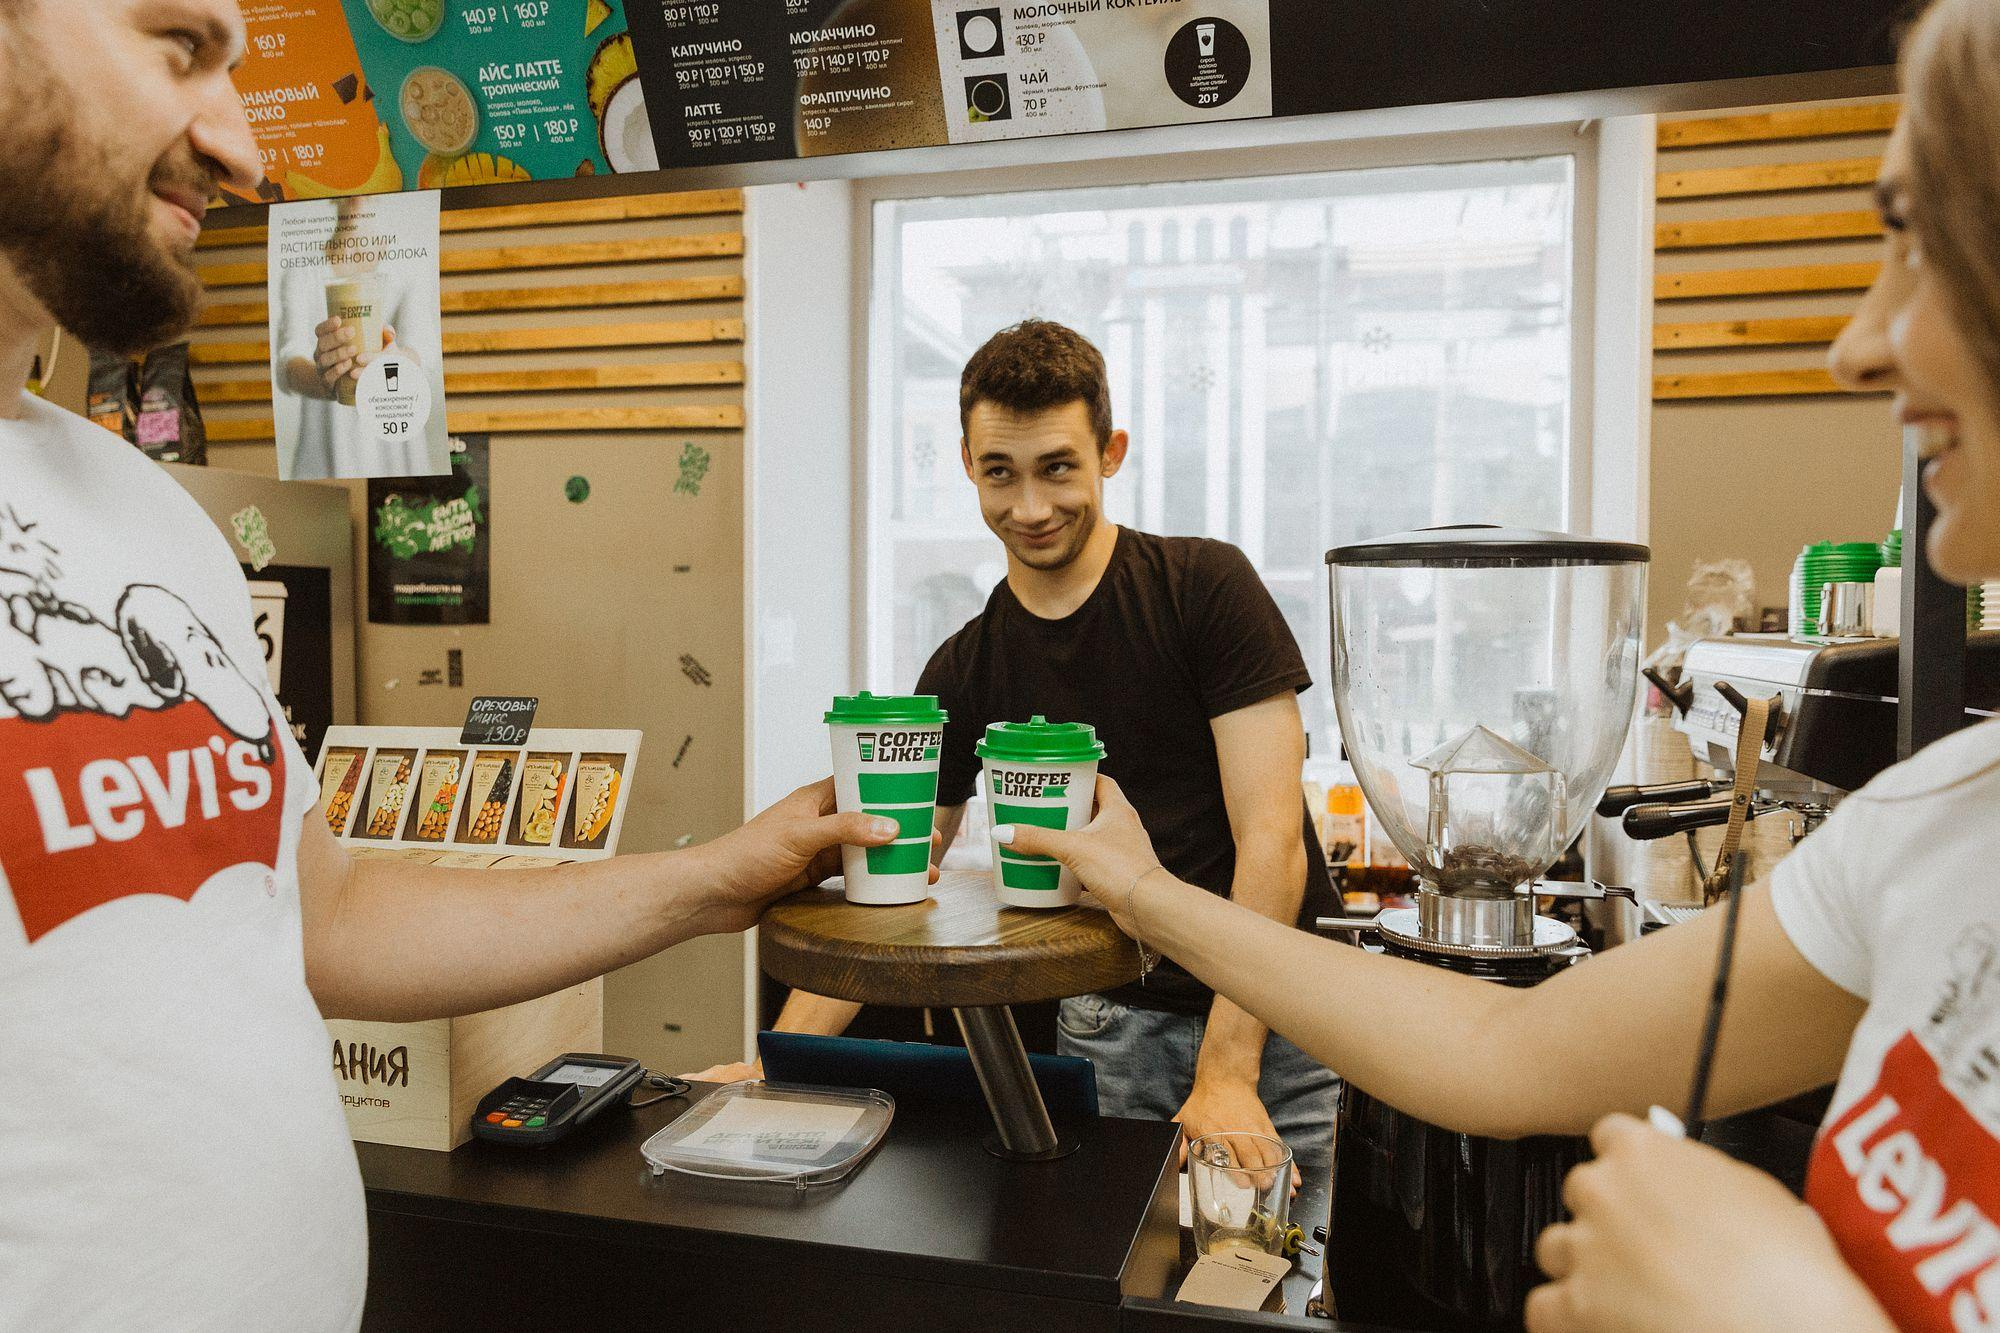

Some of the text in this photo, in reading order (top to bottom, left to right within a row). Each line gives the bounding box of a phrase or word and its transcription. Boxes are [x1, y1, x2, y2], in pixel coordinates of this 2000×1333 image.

[462, 9, 486, 25] 140
[514, 2, 537, 19] 160
[664, 9, 678, 21] 80
[694, 5, 710, 17] 110
[1013, 0, 1100, 21] МОЛОЧНЫЙ
[254, 35, 276, 50] 160
[789, 24, 877, 46] МОКАЧЧИНО
[1016, 34, 1035, 47] 130
[671, 39, 742, 58] КАПУЧИНО
[793, 57, 811, 71] 110
[826, 53, 846, 66] 140
[862, 50, 880, 64] 170
[480, 60, 562, 82] АЙС ЛАТТЕ
[676, 70, 689, 84] 90
[705, 66, 722, 79] 120
[738, 63, 755, 76] 150
[1020, 69, 1048, 84] ЧАЙ
[238, 82, 320, 108] НАНОВЫЙ
[481, 76, 559, 100] тропический
[800, 86, 892, 107] ФРАППУЧИНО
[1199, 94, 1210, 104] 20
[685, 103, 722, 117] ЛАТТЕ
[1024, 99, 1037, 110] 70
[244, 105, 285, 123] ОККО
[544, 120, 567, 135] 180
[749, 123, 767, 137] 150
[804, 118, 822, 130] 140
[493, 125, 515, 140] 150
[689, 129, 702, 143] 90
[717, 126, 734, 140] 120
[292, 145, 314, 159] 180
[281, 235, 396, 254] РАСТИТЕЛЬНОГО ИЛИ
[280, 247, 428, 269] ОБЕЗЖИРЕННОГО МОЛОКА
[383, 422, 397, 434] 50
[469, 711, 508, 725] МИКС
[878, 731, 943, 748] COFFEE
[878, 747, 923, 763] LIKE
[1004, 771, 1072, 786] COFFEE
[1004, 784, 1043, 799] LIKE
[333, 1039, 410, 1088] АНИЯ
